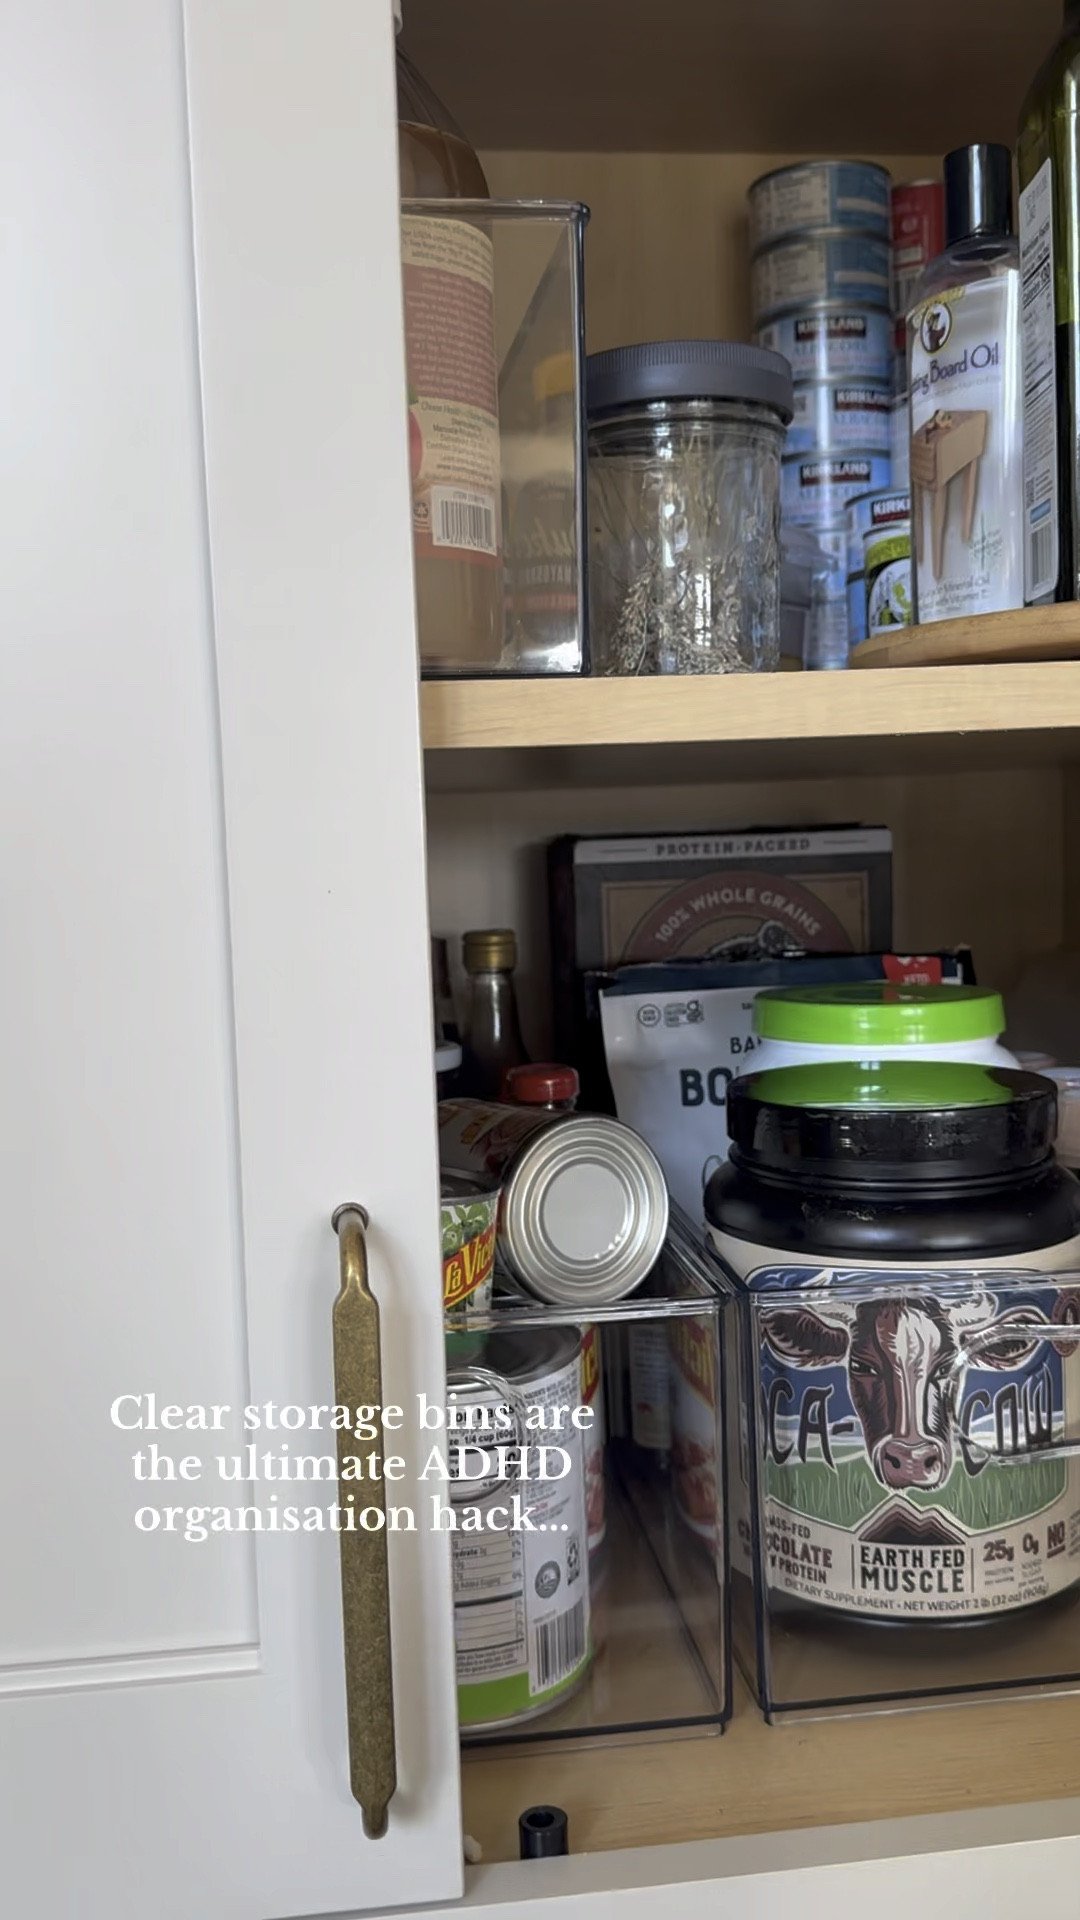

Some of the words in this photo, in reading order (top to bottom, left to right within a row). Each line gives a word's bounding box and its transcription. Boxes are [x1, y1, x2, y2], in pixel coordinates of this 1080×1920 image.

[929, 348, 968, 385] Board
[970, 341, 999, 369] Oil
[655, 906, 691, 943] 100%
[689, 887, 757, 912] WHOLE
[759, 891, 822, 937] GRAINS
[478, 1433, 495, 1443] cup
[1046, 1520, 1066, 1550] NO
[860, 1544, 925, 1569] EARTH
[929, 1547, 966, 1569] FED
[982, 1538, 1015, 1562] 25g
[778, 1557, 828, 1585] PROTEIN
[860, 1565, 965, 1594] MUSCLE
[784, 1577, 824, 1597] DIETARY
[824, 1588, 894, 1611] SUPPLEMENT
[903, 1600, 925, 1612] NET
[926, 1599, 970, 1612] WEIGHT
